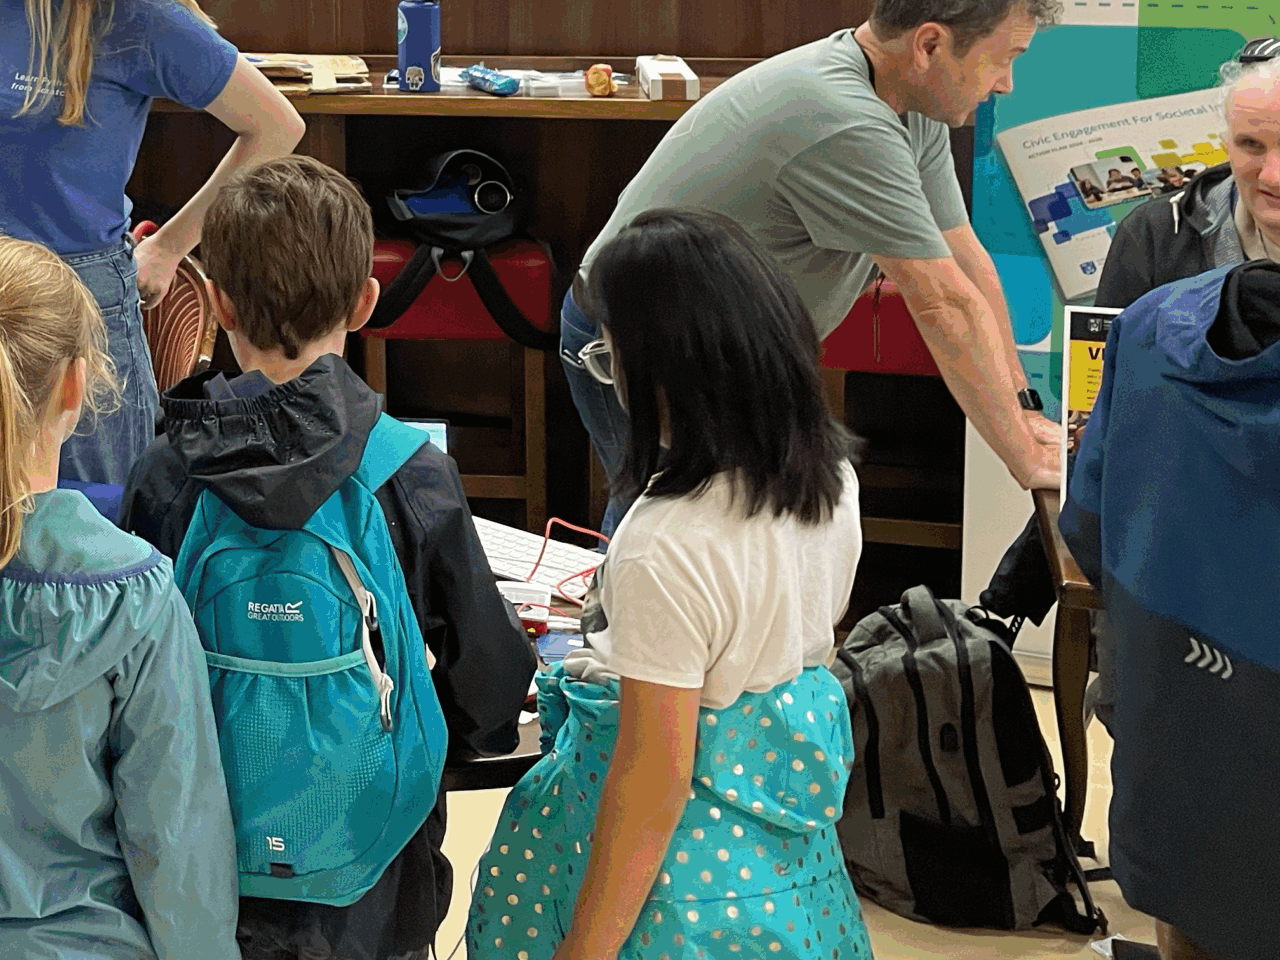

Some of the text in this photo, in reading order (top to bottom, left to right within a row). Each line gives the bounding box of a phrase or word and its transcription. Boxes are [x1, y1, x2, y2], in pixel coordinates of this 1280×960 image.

[1022, 135, 1052, 149] Civic
[1052, 118, 1132, 141] Engagement
[1132, 114, 1153, 124] For
[1155, 104, 1208, 121] Societal
[248, 601, 285, 613] REGATTA
[247, 611, 304, 622] GREAT OUTDOORS
[266, 836, 285, 851] 15
